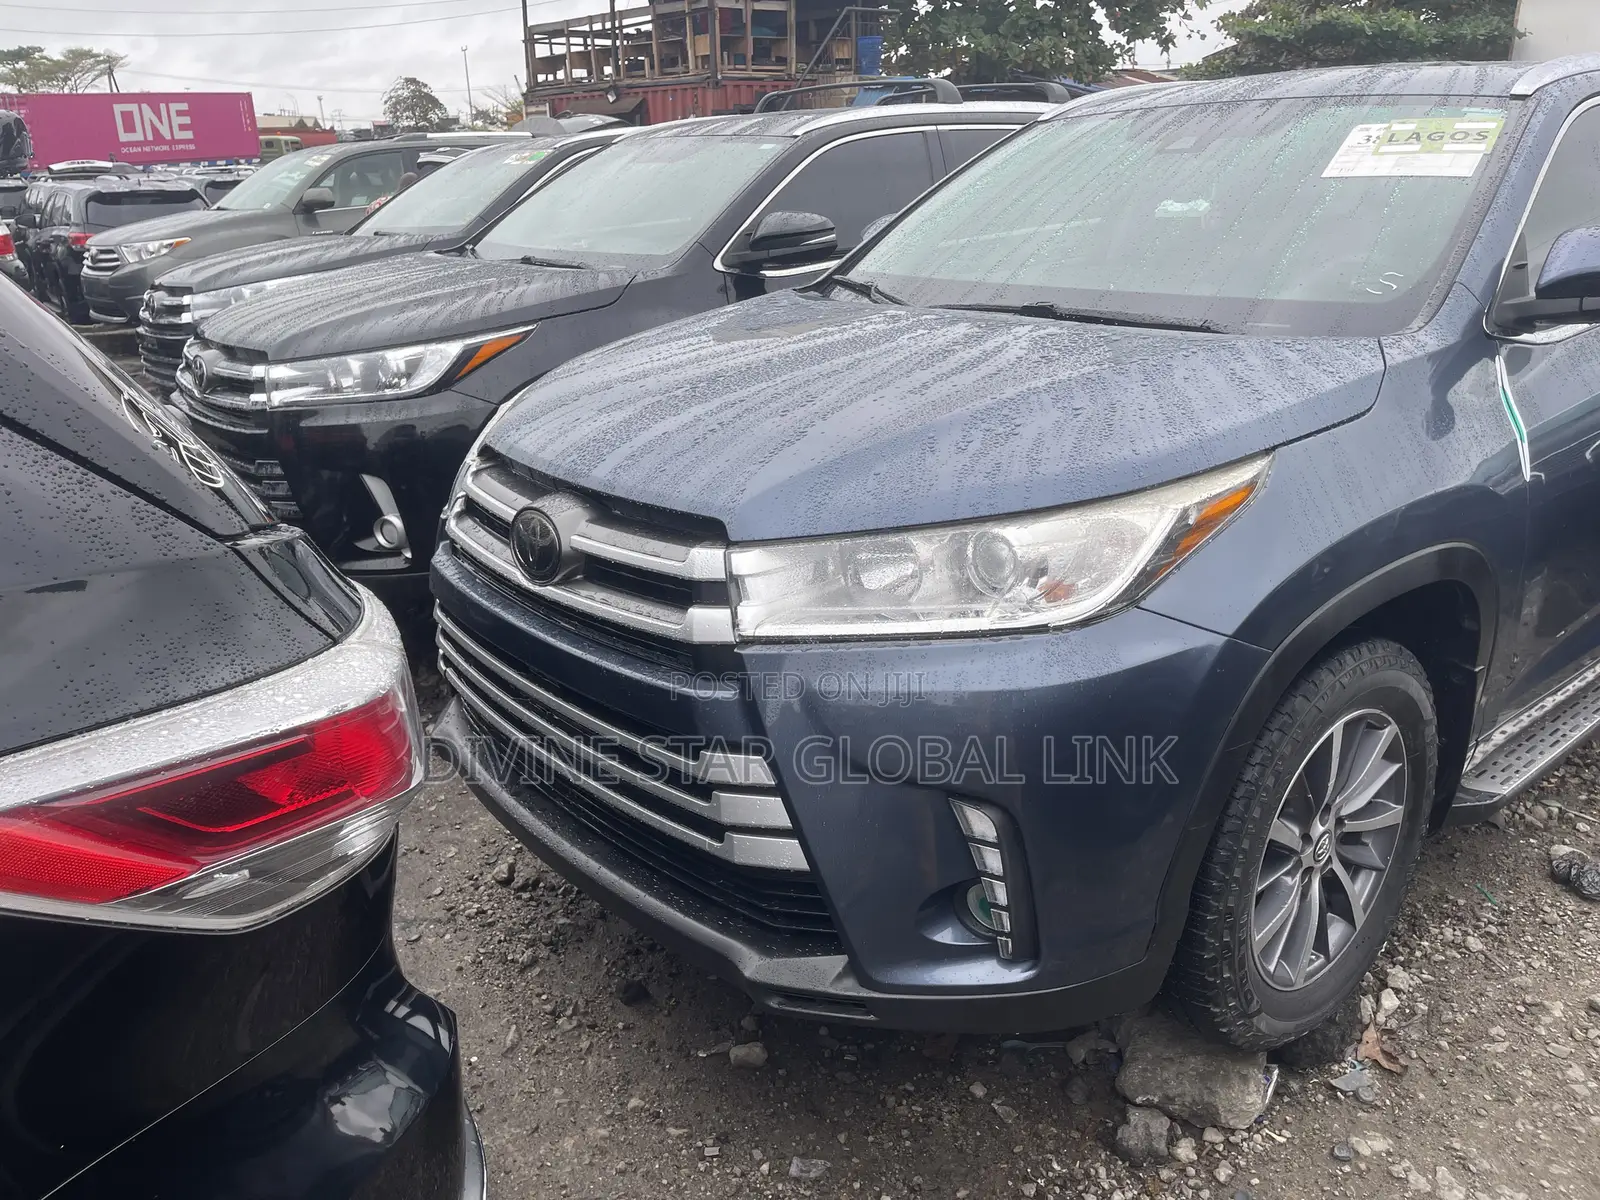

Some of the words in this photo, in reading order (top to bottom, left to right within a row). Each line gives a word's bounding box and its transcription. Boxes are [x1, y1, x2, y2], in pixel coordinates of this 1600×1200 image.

[113, 102, 194, 142] ONE
[1387, 130, 1490, 143] LAGOS
[120, 146, 142, 154] OCEAN
